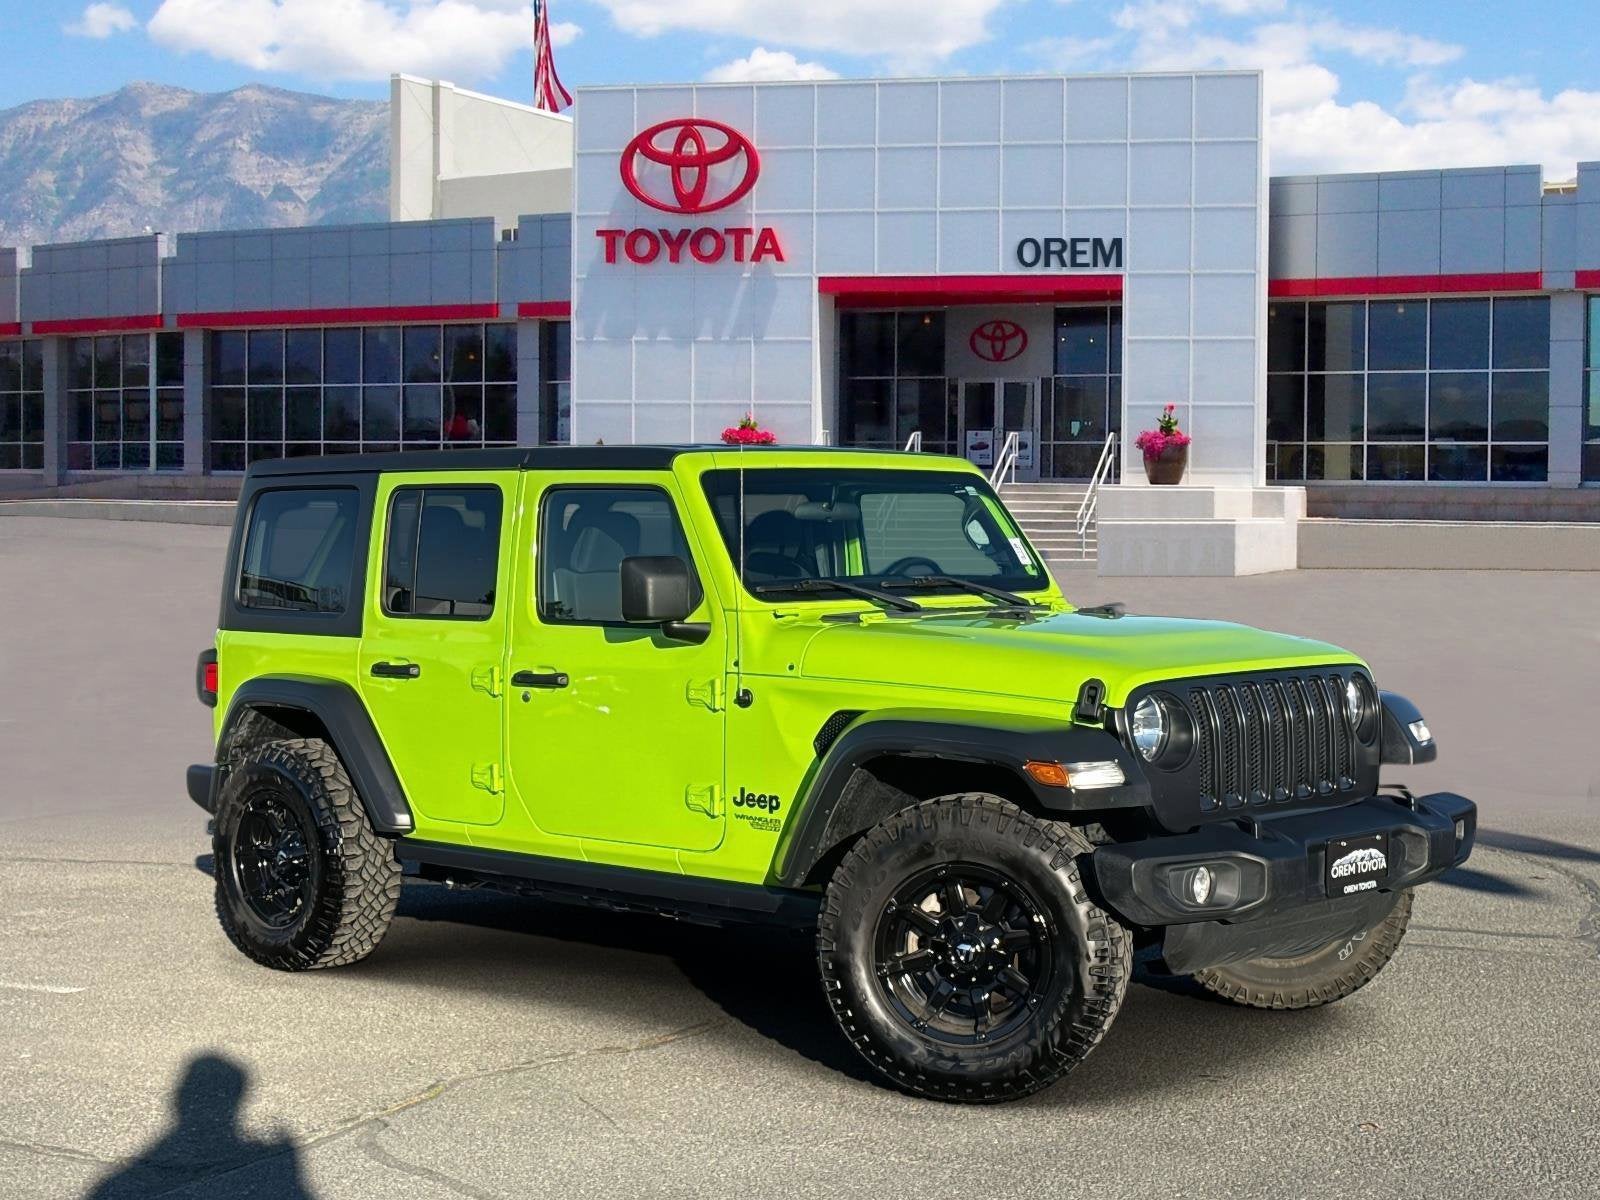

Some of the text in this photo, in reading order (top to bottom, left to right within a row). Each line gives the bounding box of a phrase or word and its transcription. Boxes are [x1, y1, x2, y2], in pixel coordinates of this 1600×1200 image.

[596, 228, 784, 264] TOYOTA
[1017, 237, 1123, 268] OREM
[733, 787, 780, 814] Jeep
[734, 813, 781, 825] WRANGLER
[1331, 857, 1387, 879] OREM TOYOTA
[1343, 880, 1377, 894] OREM TOYOTA
